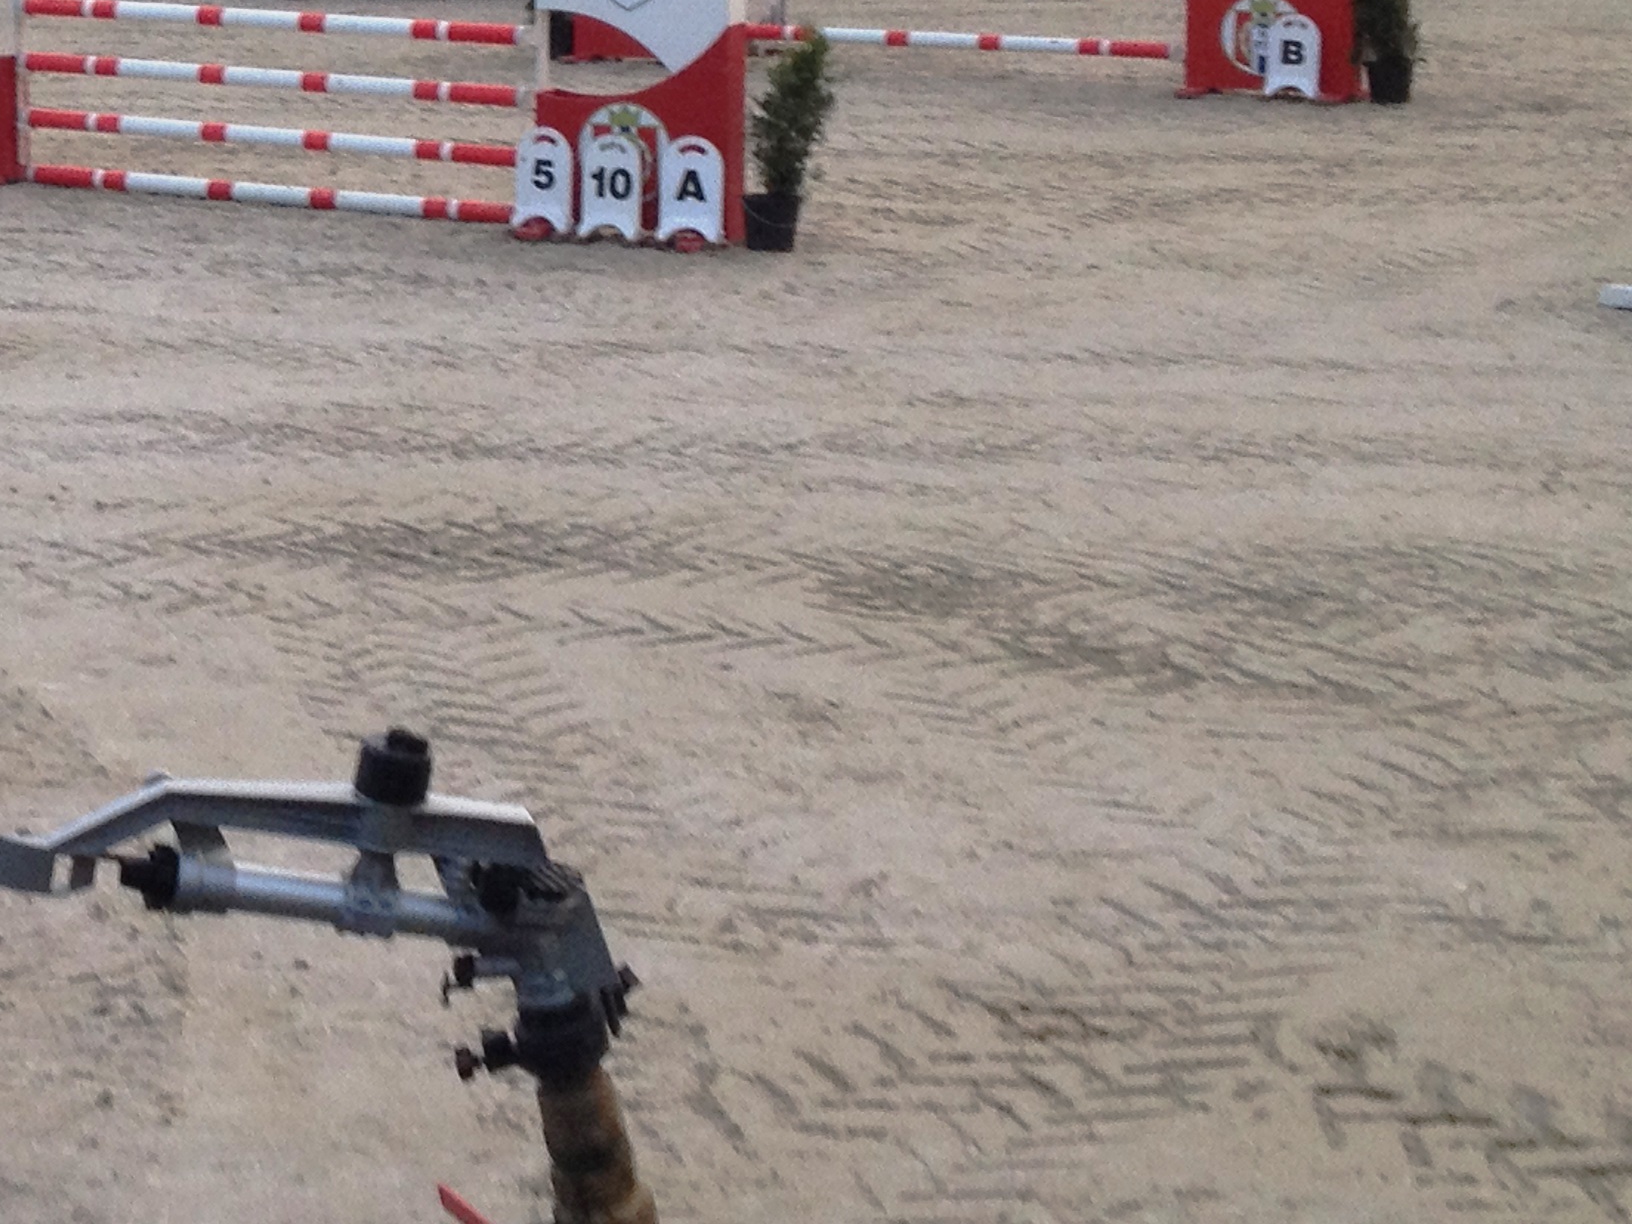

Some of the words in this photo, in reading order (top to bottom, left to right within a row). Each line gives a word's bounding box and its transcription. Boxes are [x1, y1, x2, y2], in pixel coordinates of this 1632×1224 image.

[1281, 39, 1304, 66] B
[532, 159, 555, 190] 5
[591, 166, 632, 200] 10
[675, 169, 707, 202] A
